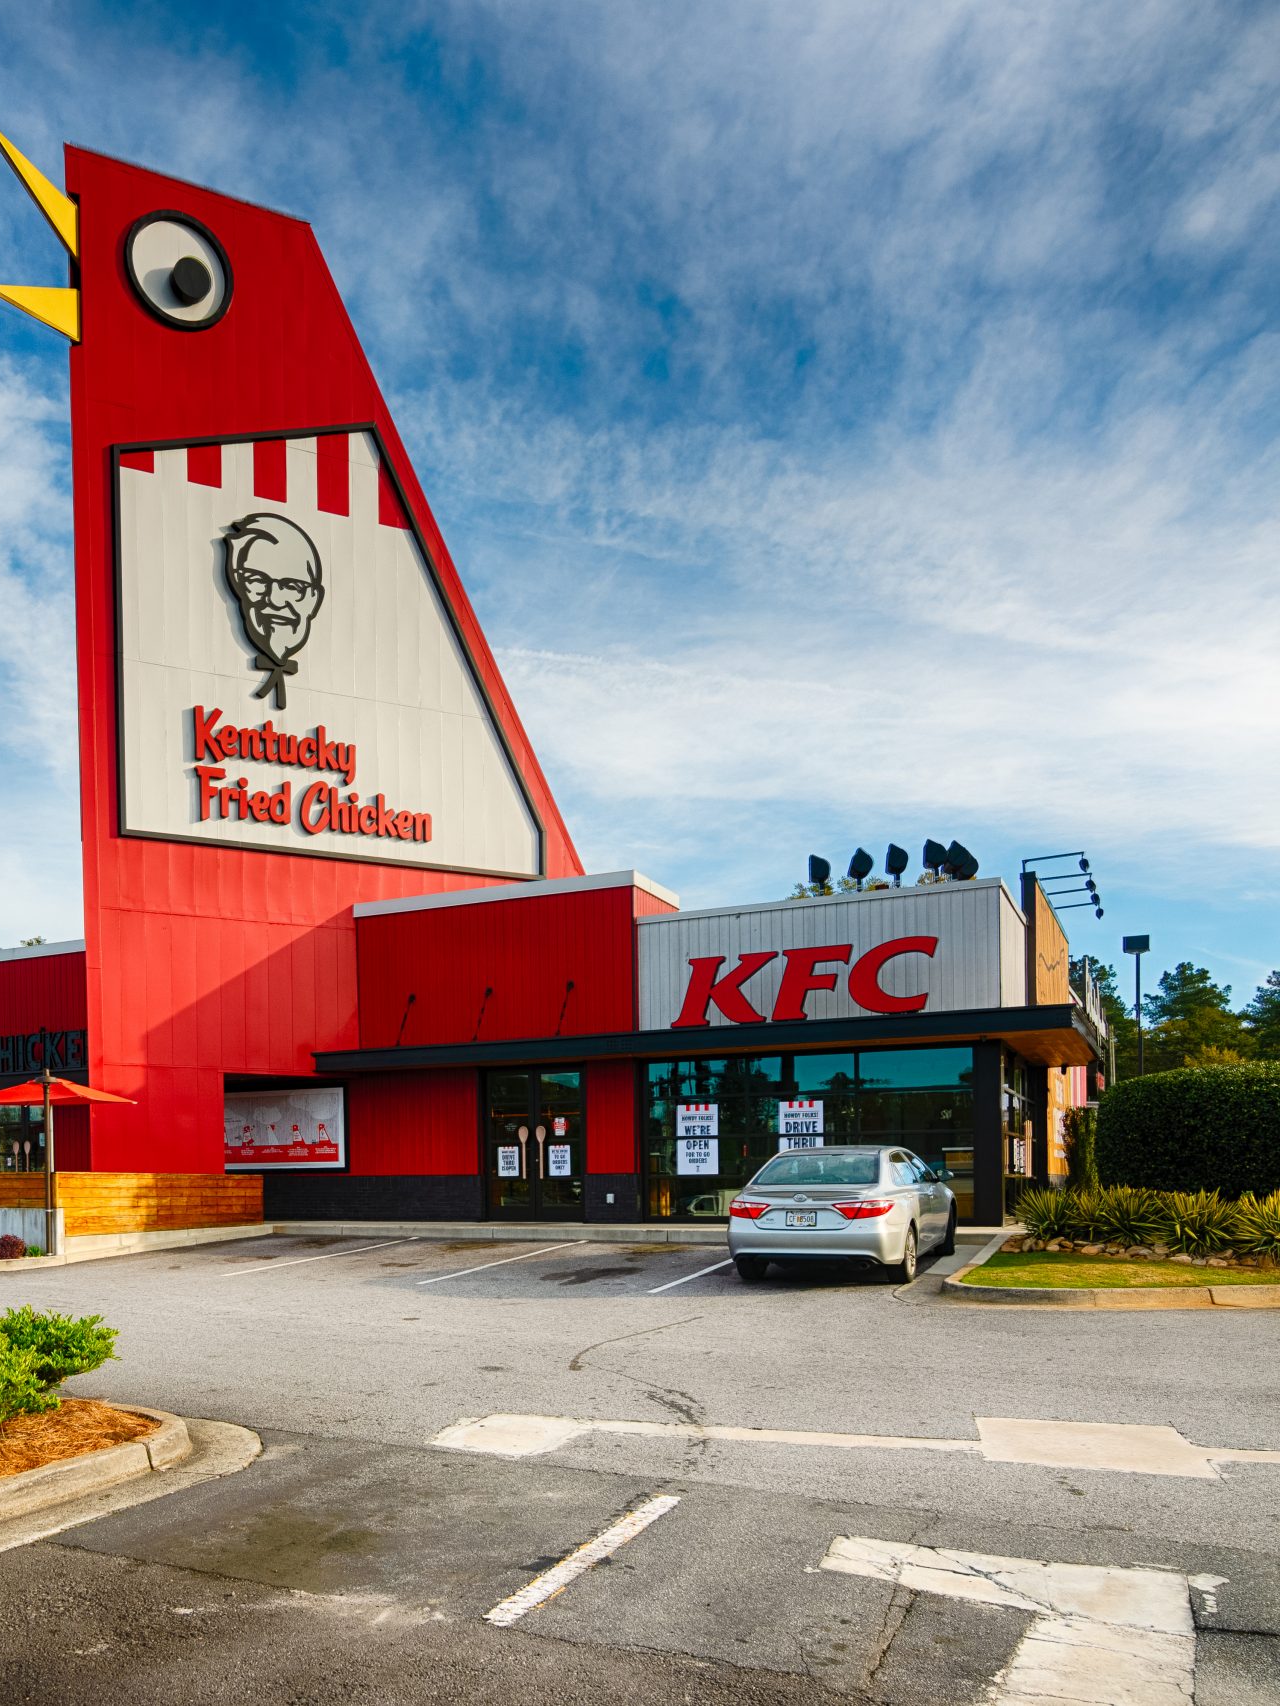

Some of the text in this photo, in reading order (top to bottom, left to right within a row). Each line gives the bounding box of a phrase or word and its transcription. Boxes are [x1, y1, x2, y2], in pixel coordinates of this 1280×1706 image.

[194, 704, 356, 786] Kentucky
[194, 765, 433, 843] Fried Chicken
[671, 935, 939, 1029] KFC
[684, 1125, 712, 1136] WE'RE
[785, 1121, 818, 1133] DRIVE
[686, 1140, 710, 1150] OPEN
[787, 1137, 817, 1148] THRU
